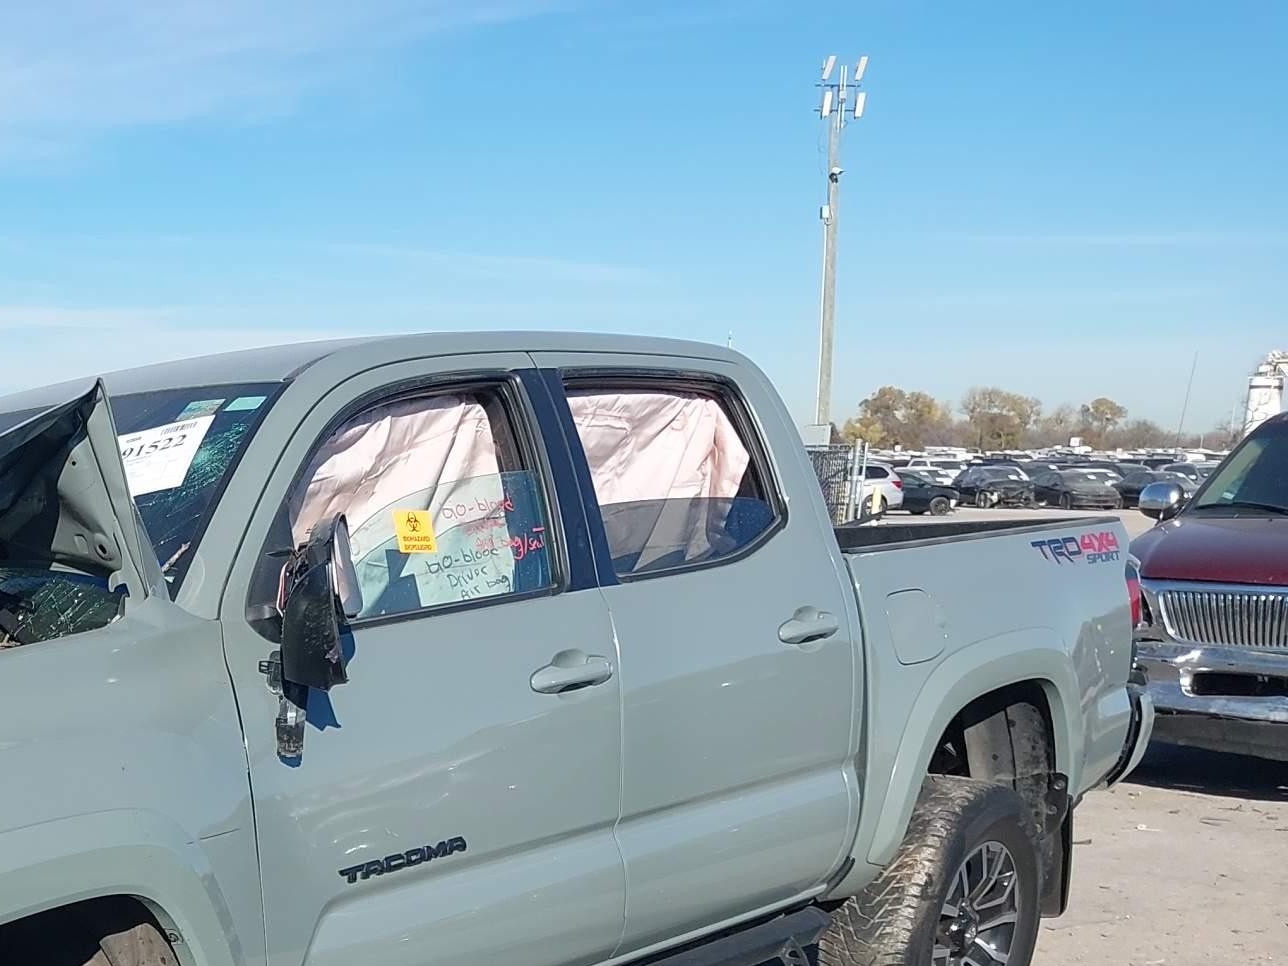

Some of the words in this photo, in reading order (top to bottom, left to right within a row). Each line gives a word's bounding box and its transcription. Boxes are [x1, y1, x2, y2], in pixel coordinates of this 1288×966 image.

[1030, 536, 1082, 564] TRD
[1086, 550, 1121, 564] SPORT
[338, 836, 467, 883] TACOMA
